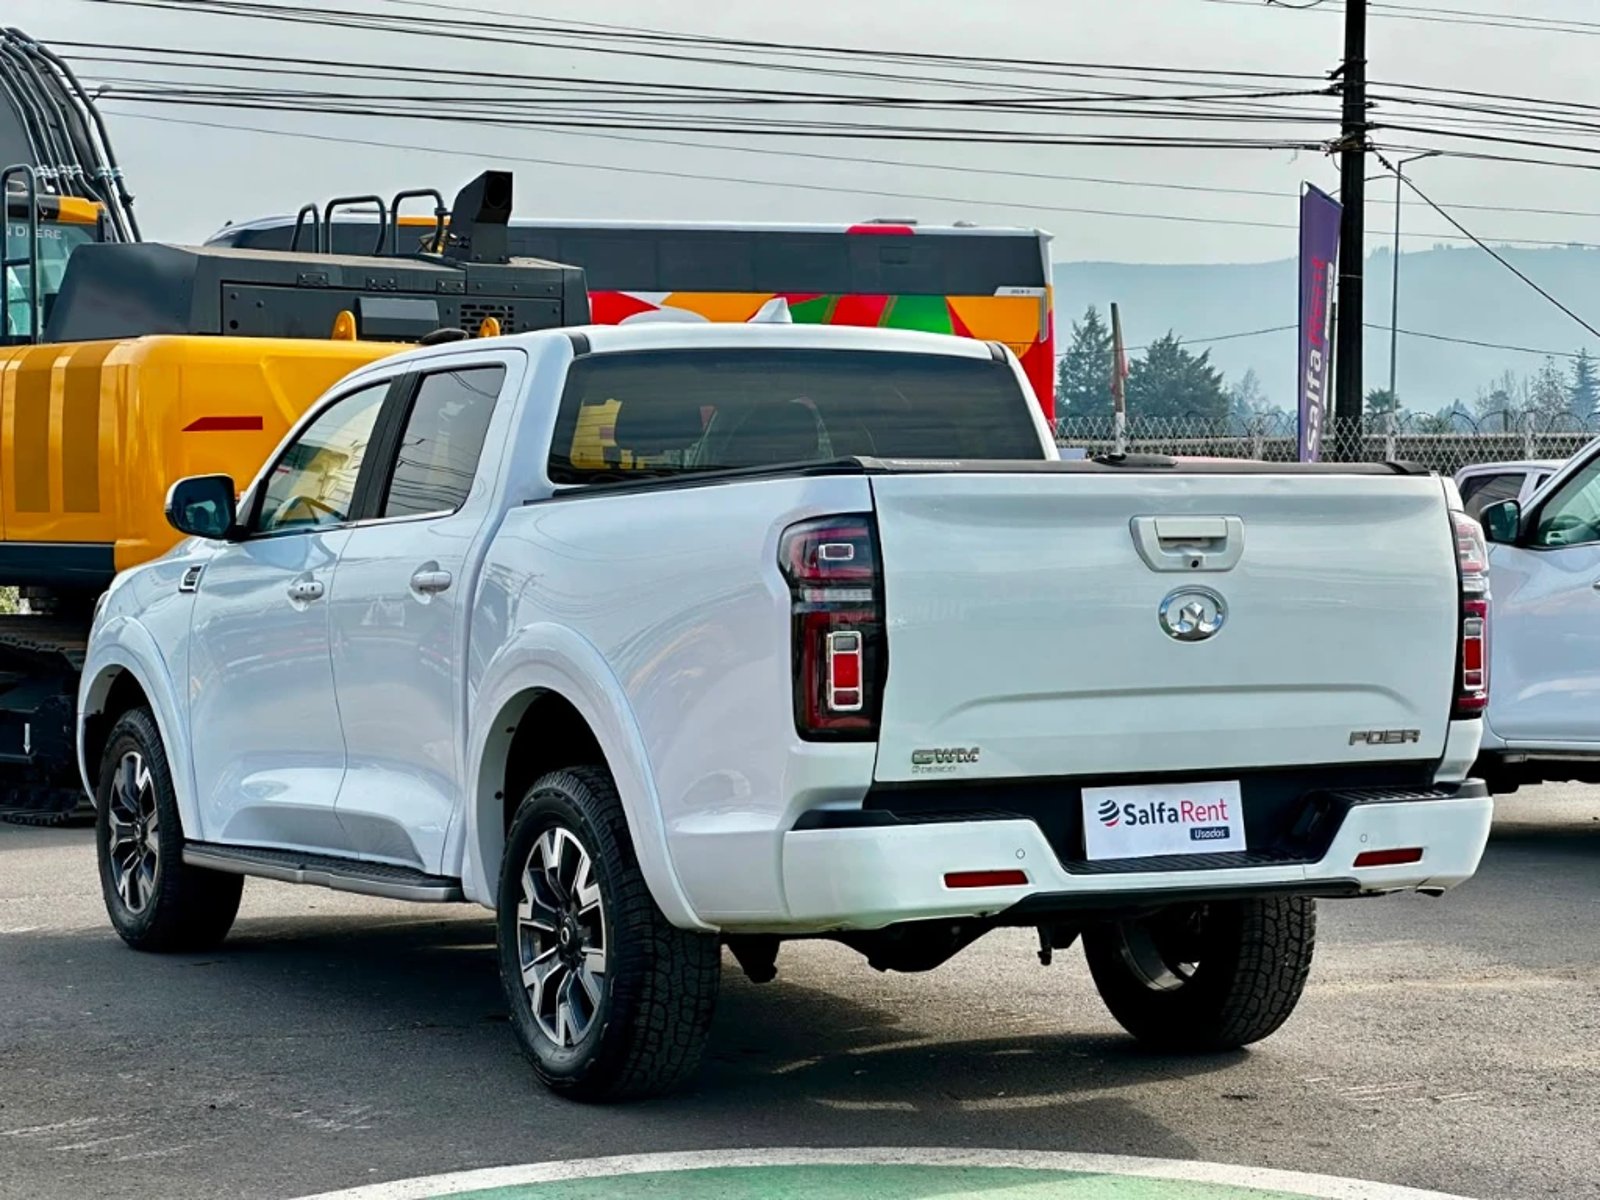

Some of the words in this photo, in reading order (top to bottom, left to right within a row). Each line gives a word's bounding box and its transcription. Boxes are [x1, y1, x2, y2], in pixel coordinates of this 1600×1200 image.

[912, 747, 979, 764] GWM
[1123, 799, 1228, 825] SalfaRent
[1194, 827, 1225, 839] Usados
